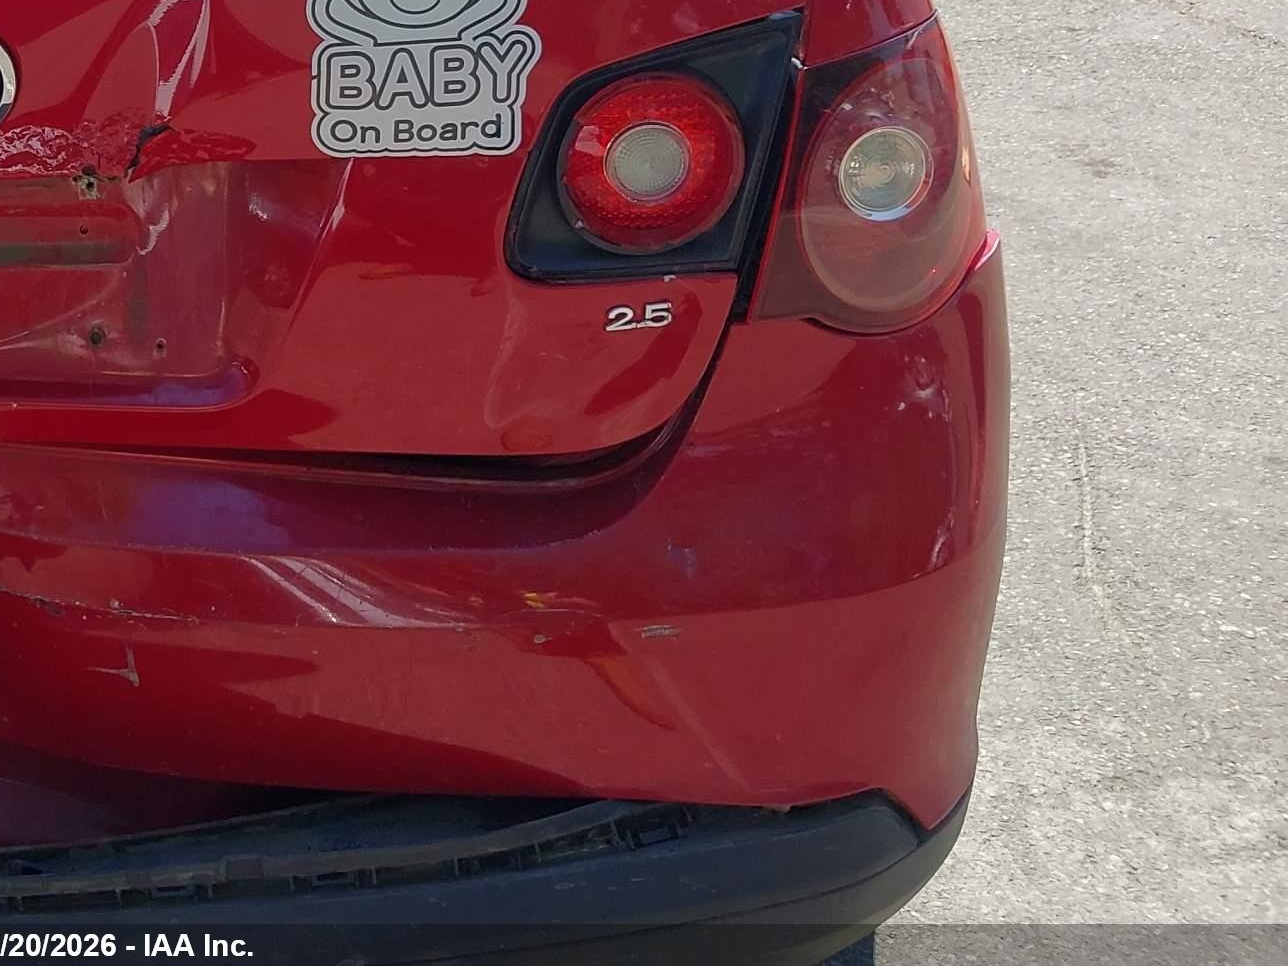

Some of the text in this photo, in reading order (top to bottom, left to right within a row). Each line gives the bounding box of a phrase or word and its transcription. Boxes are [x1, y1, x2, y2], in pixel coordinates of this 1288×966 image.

[326, 39, 528, 111] BABY
[330, 112, 502, 144] On Board
